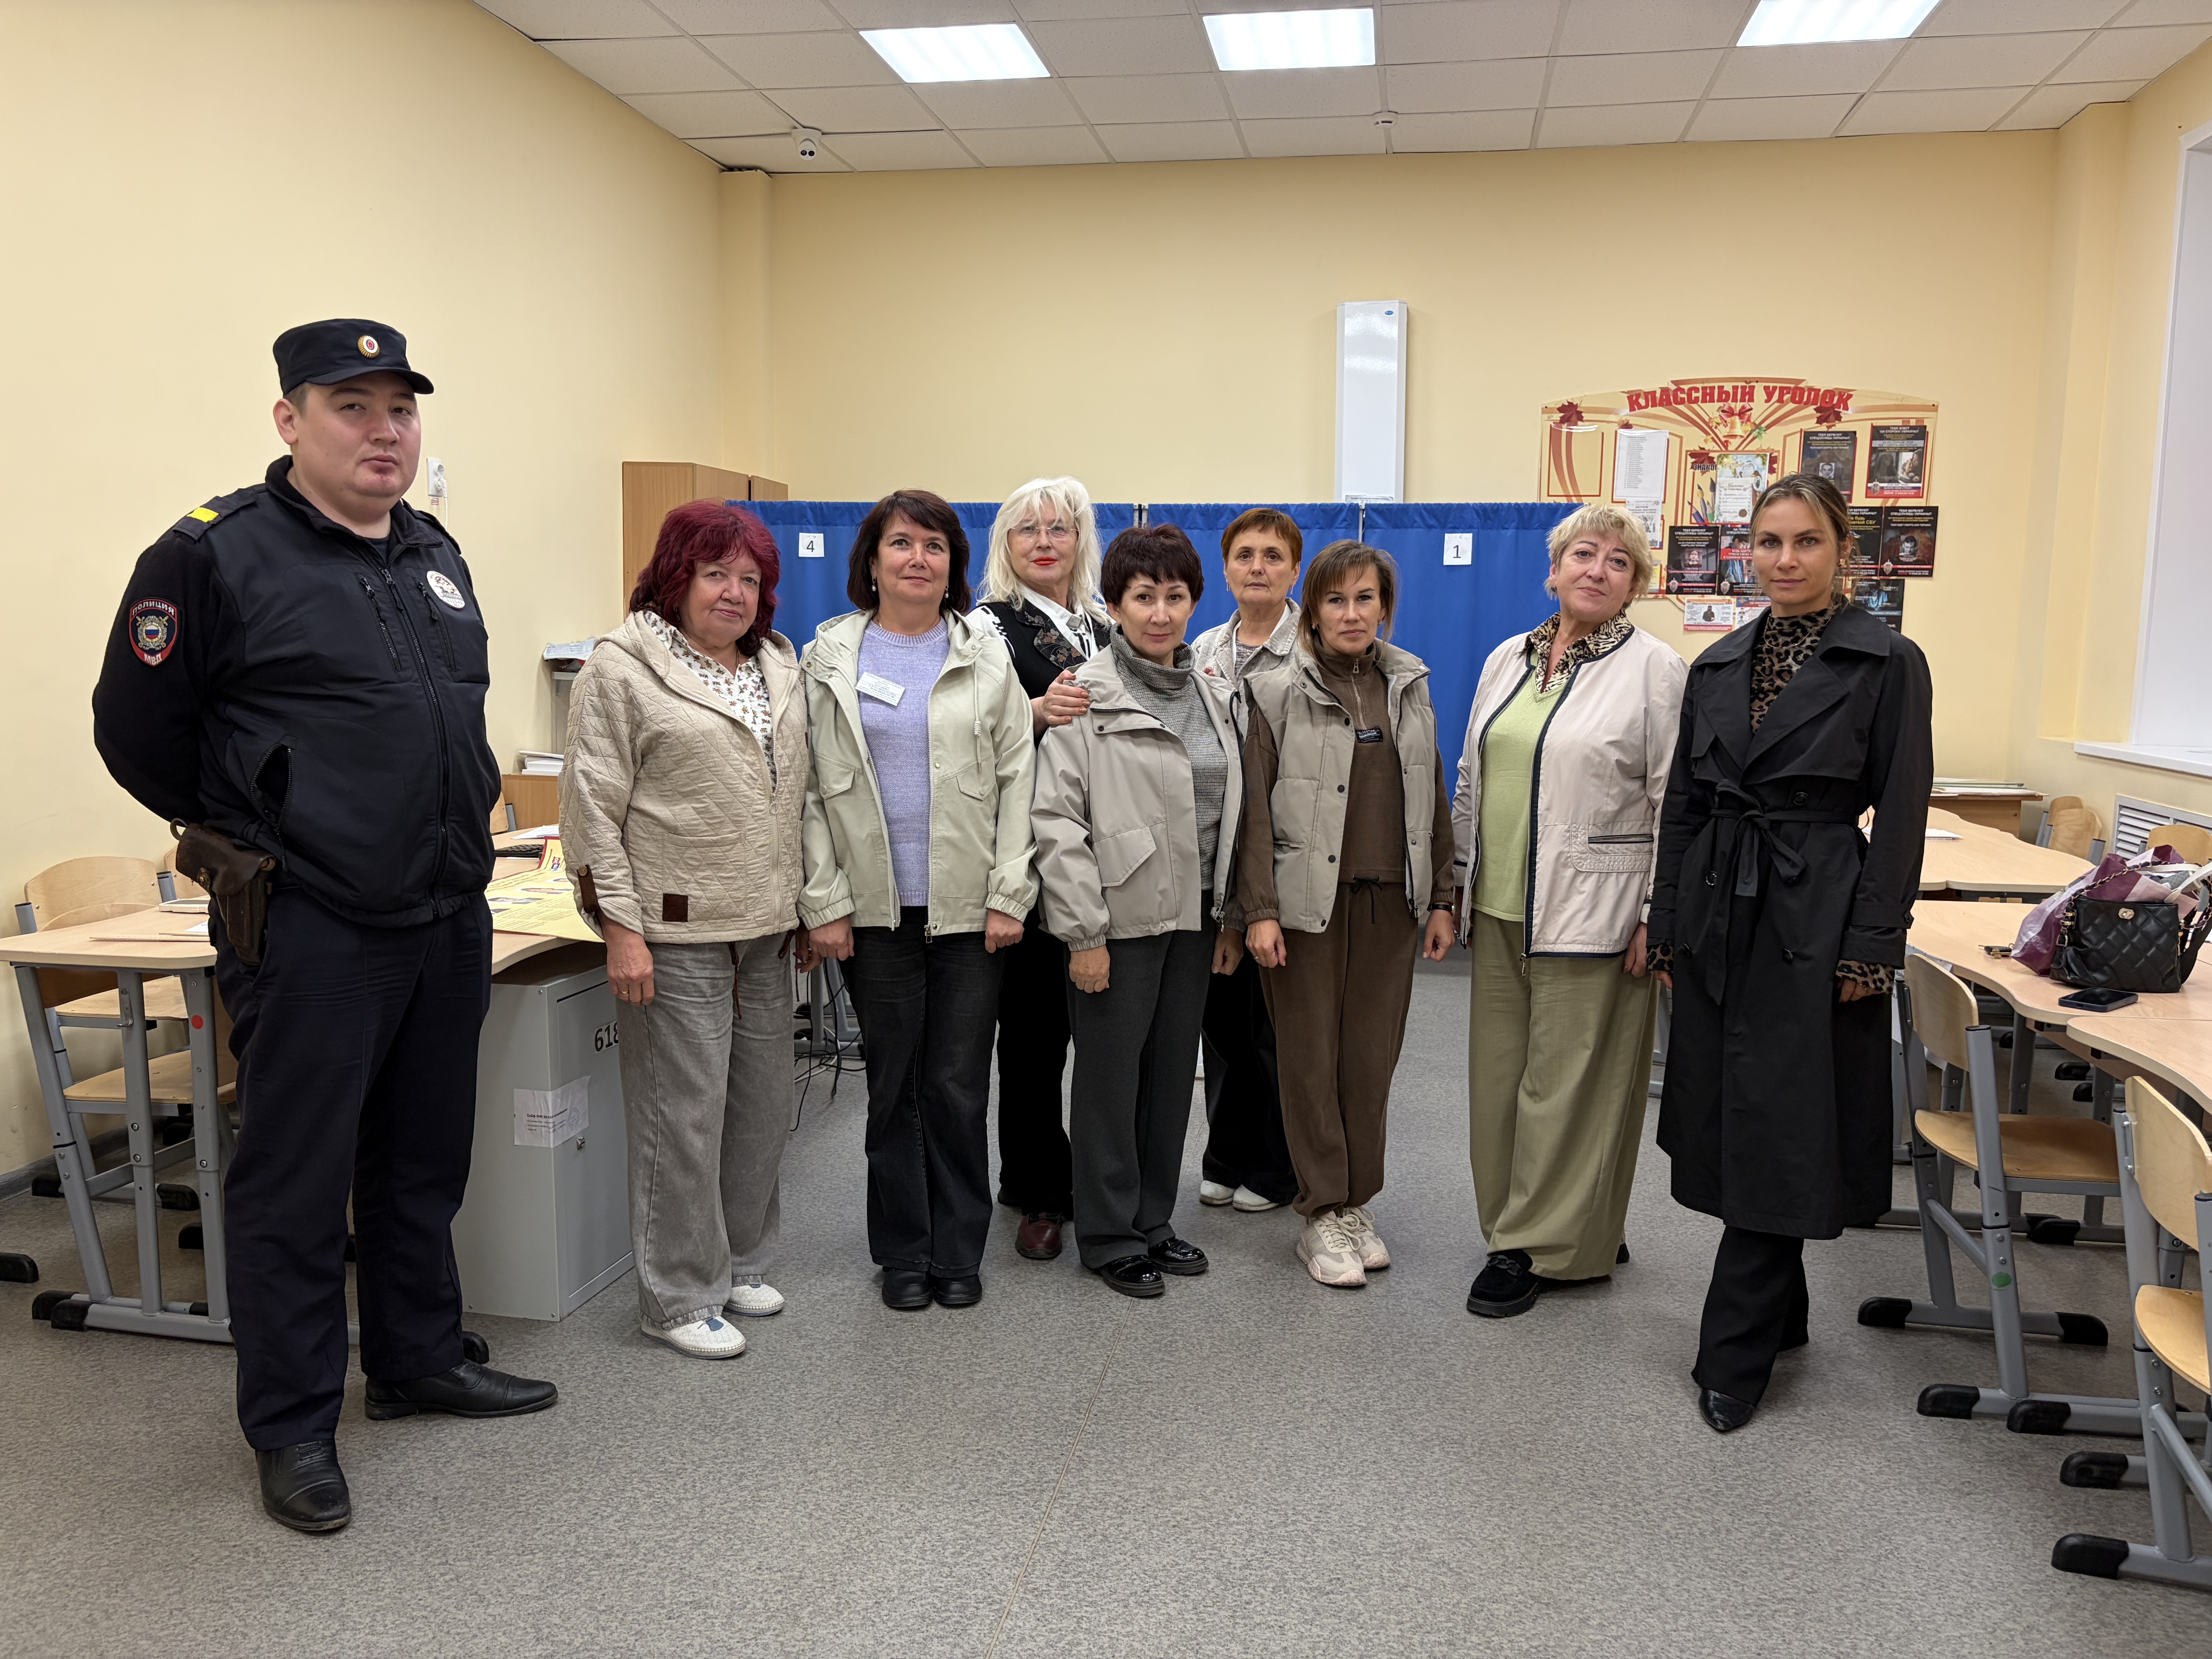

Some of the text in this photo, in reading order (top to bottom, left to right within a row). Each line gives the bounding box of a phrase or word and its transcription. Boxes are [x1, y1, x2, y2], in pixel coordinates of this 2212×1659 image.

[1627, 381, 1853, 412] КЛАССНЫЙ УГОЛОК
[806, 540, 815, 552] 4
[1453, 545, 1461, 558] 1
[132, 601, 174, 616] ПОЛИЦИЯ
[144, 653, 162, 666] МВД
[595, 1022, 618, 1052] 618
